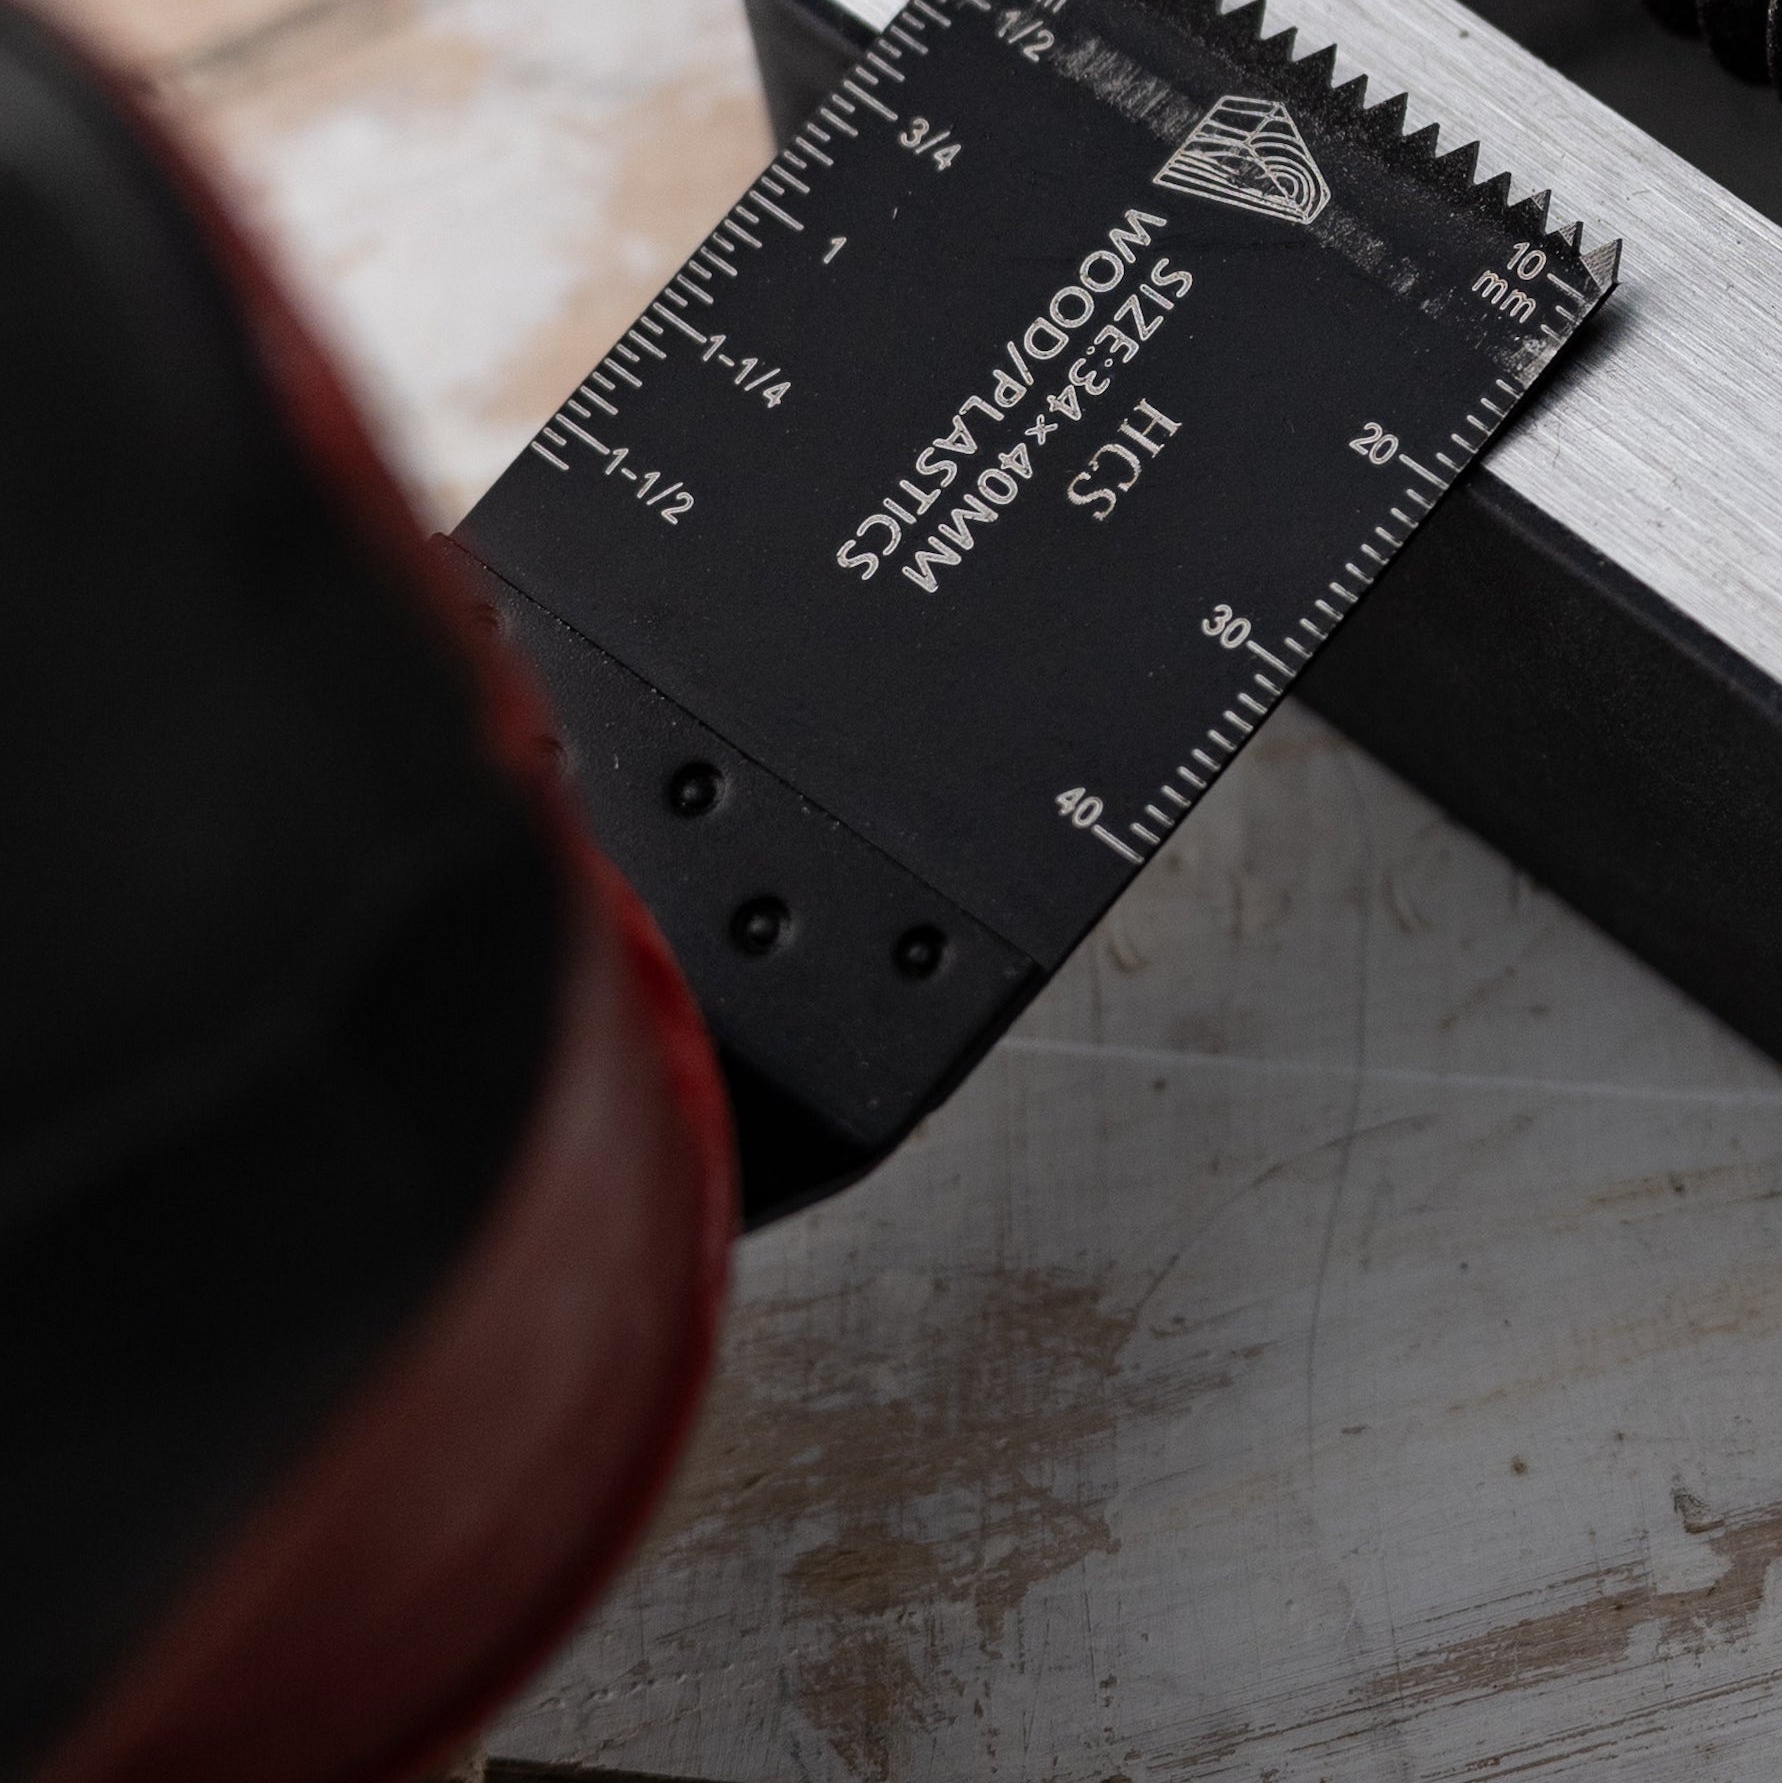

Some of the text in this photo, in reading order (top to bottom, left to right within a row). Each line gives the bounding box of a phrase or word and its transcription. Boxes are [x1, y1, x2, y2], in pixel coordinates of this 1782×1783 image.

[998, 10, 1055, 62] 1/2
[900, 118, 962, 171] 3/4
[823, 236, 847, 265] 1
[1505, 241, 1547, 281] 10
[1471, 269, 1537, 324] mm
[702, 334, 792, 408] 1-1/4
[836, 208, 1168, 581] WOOD/PLASTICS
[1067, 397, 1183, 521] HCS
[1349, 421, 1400, 466] 20
[605, 448, 695, 525] 1-1/2
[1202, 604, 1252, 650] 30
[1055, 786, 1104, 829] 40
